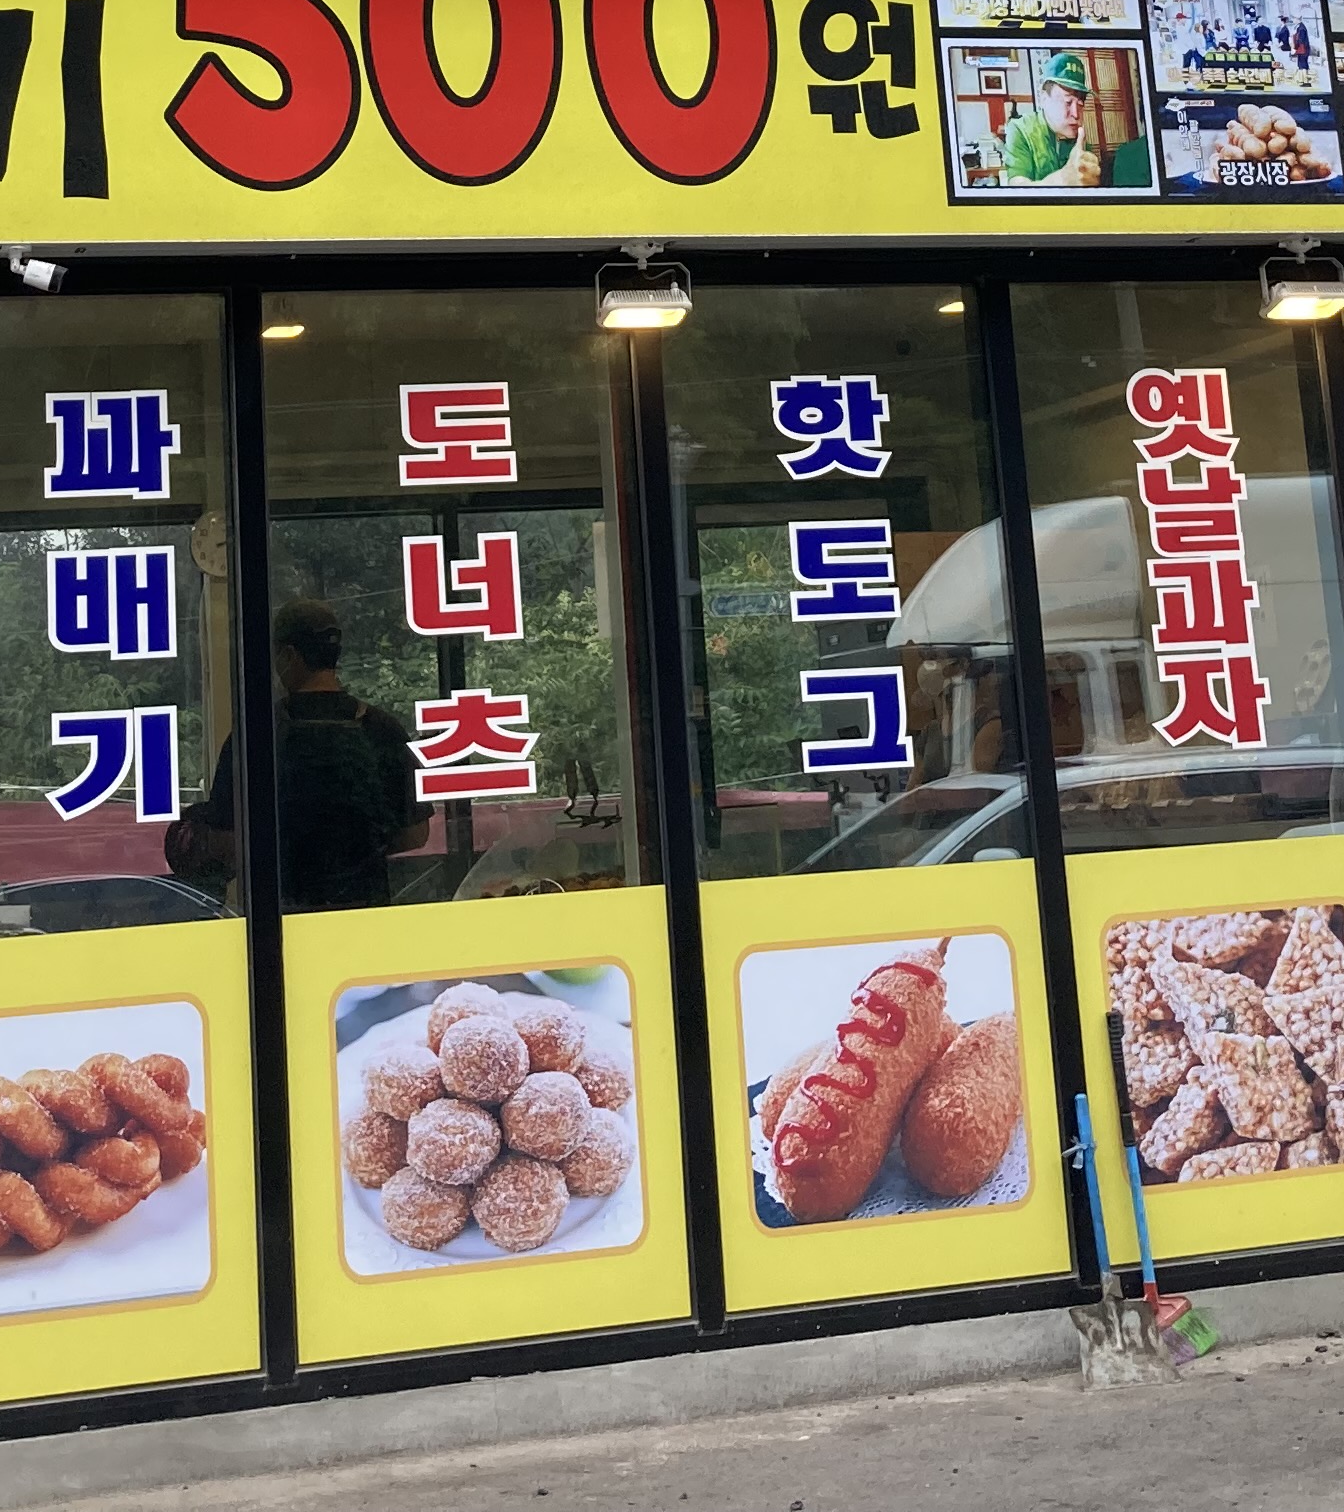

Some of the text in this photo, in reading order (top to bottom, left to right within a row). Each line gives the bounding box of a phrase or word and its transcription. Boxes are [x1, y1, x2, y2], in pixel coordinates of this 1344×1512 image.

[1220, 162, 1289, 186] 광장시장
[399, 382, 540, 802] 도너츠
[770, 374, 914, 773] 핫도그
